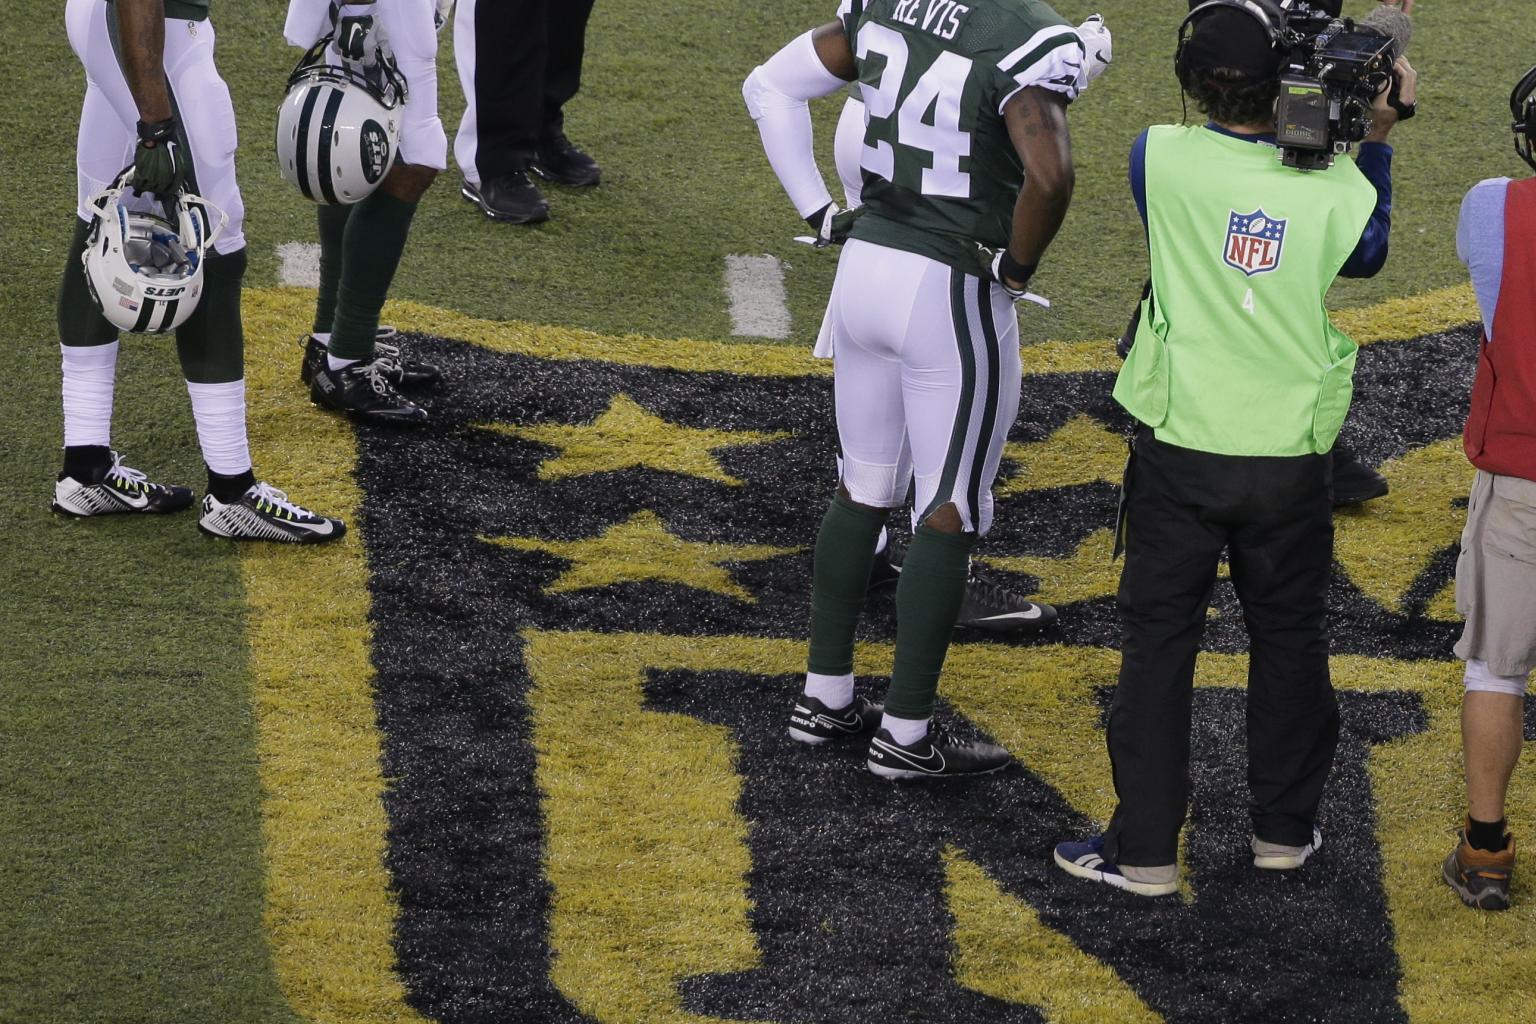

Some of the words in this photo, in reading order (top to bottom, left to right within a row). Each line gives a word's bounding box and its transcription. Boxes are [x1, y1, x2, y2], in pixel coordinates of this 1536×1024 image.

[856, 20, 974, 199] 24
[369, 131, 382, 176] JETS
[1228, 234, 1274, 269] NFL
[144, 286, 187, 297] JETS
[1241, 287, 1255, 315] 4
